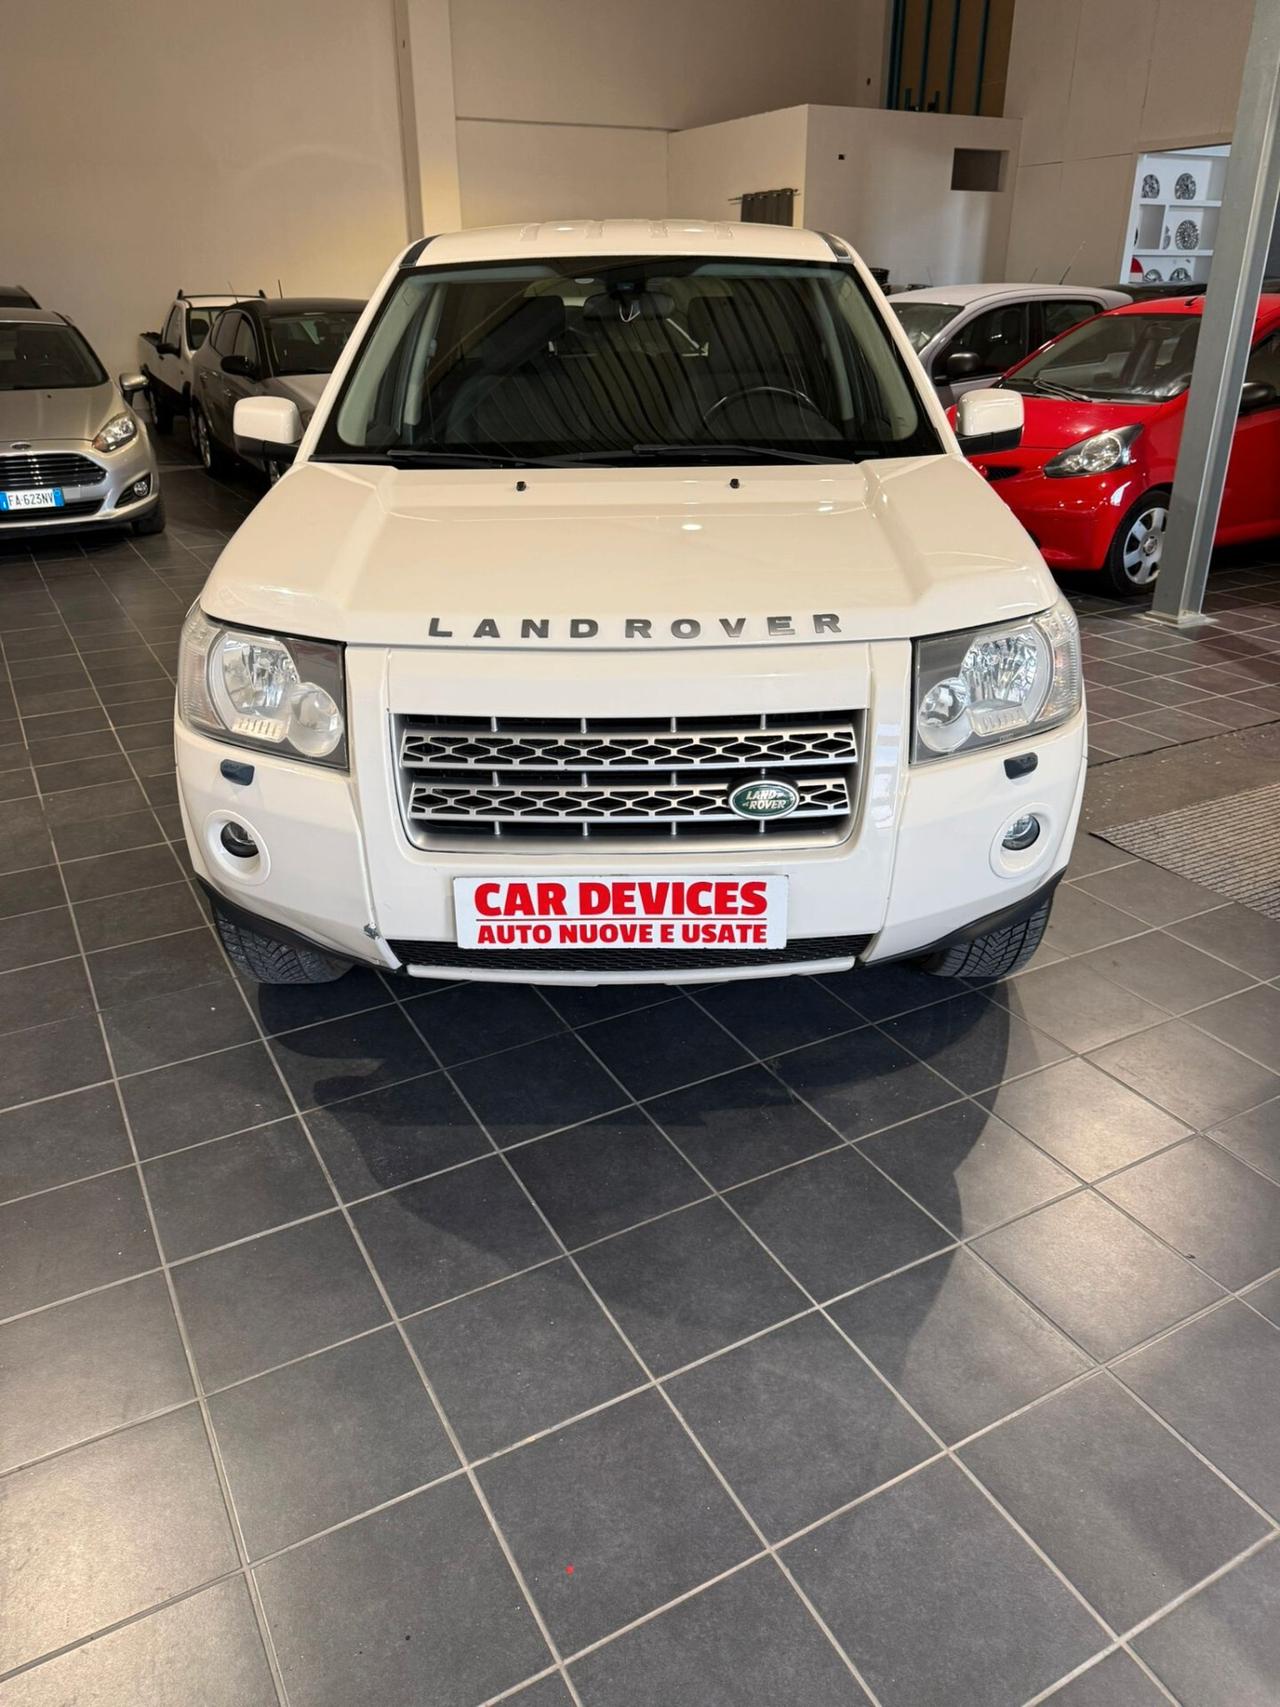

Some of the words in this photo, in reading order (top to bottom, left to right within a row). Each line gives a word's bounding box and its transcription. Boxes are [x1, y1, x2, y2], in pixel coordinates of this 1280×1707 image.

[745, 789, 777, 800] LAND
[748, 800, 786, 810] ROVER
[474, 882, 567, 917] CAR
[578, 881, 768, 916] DEVICES
[477, 925, 552, 944] AUTO
[559, 924, 653, 944] NUOVE
[660, 924, 675, 943] E
[681, 924, 767, 943] USATE
